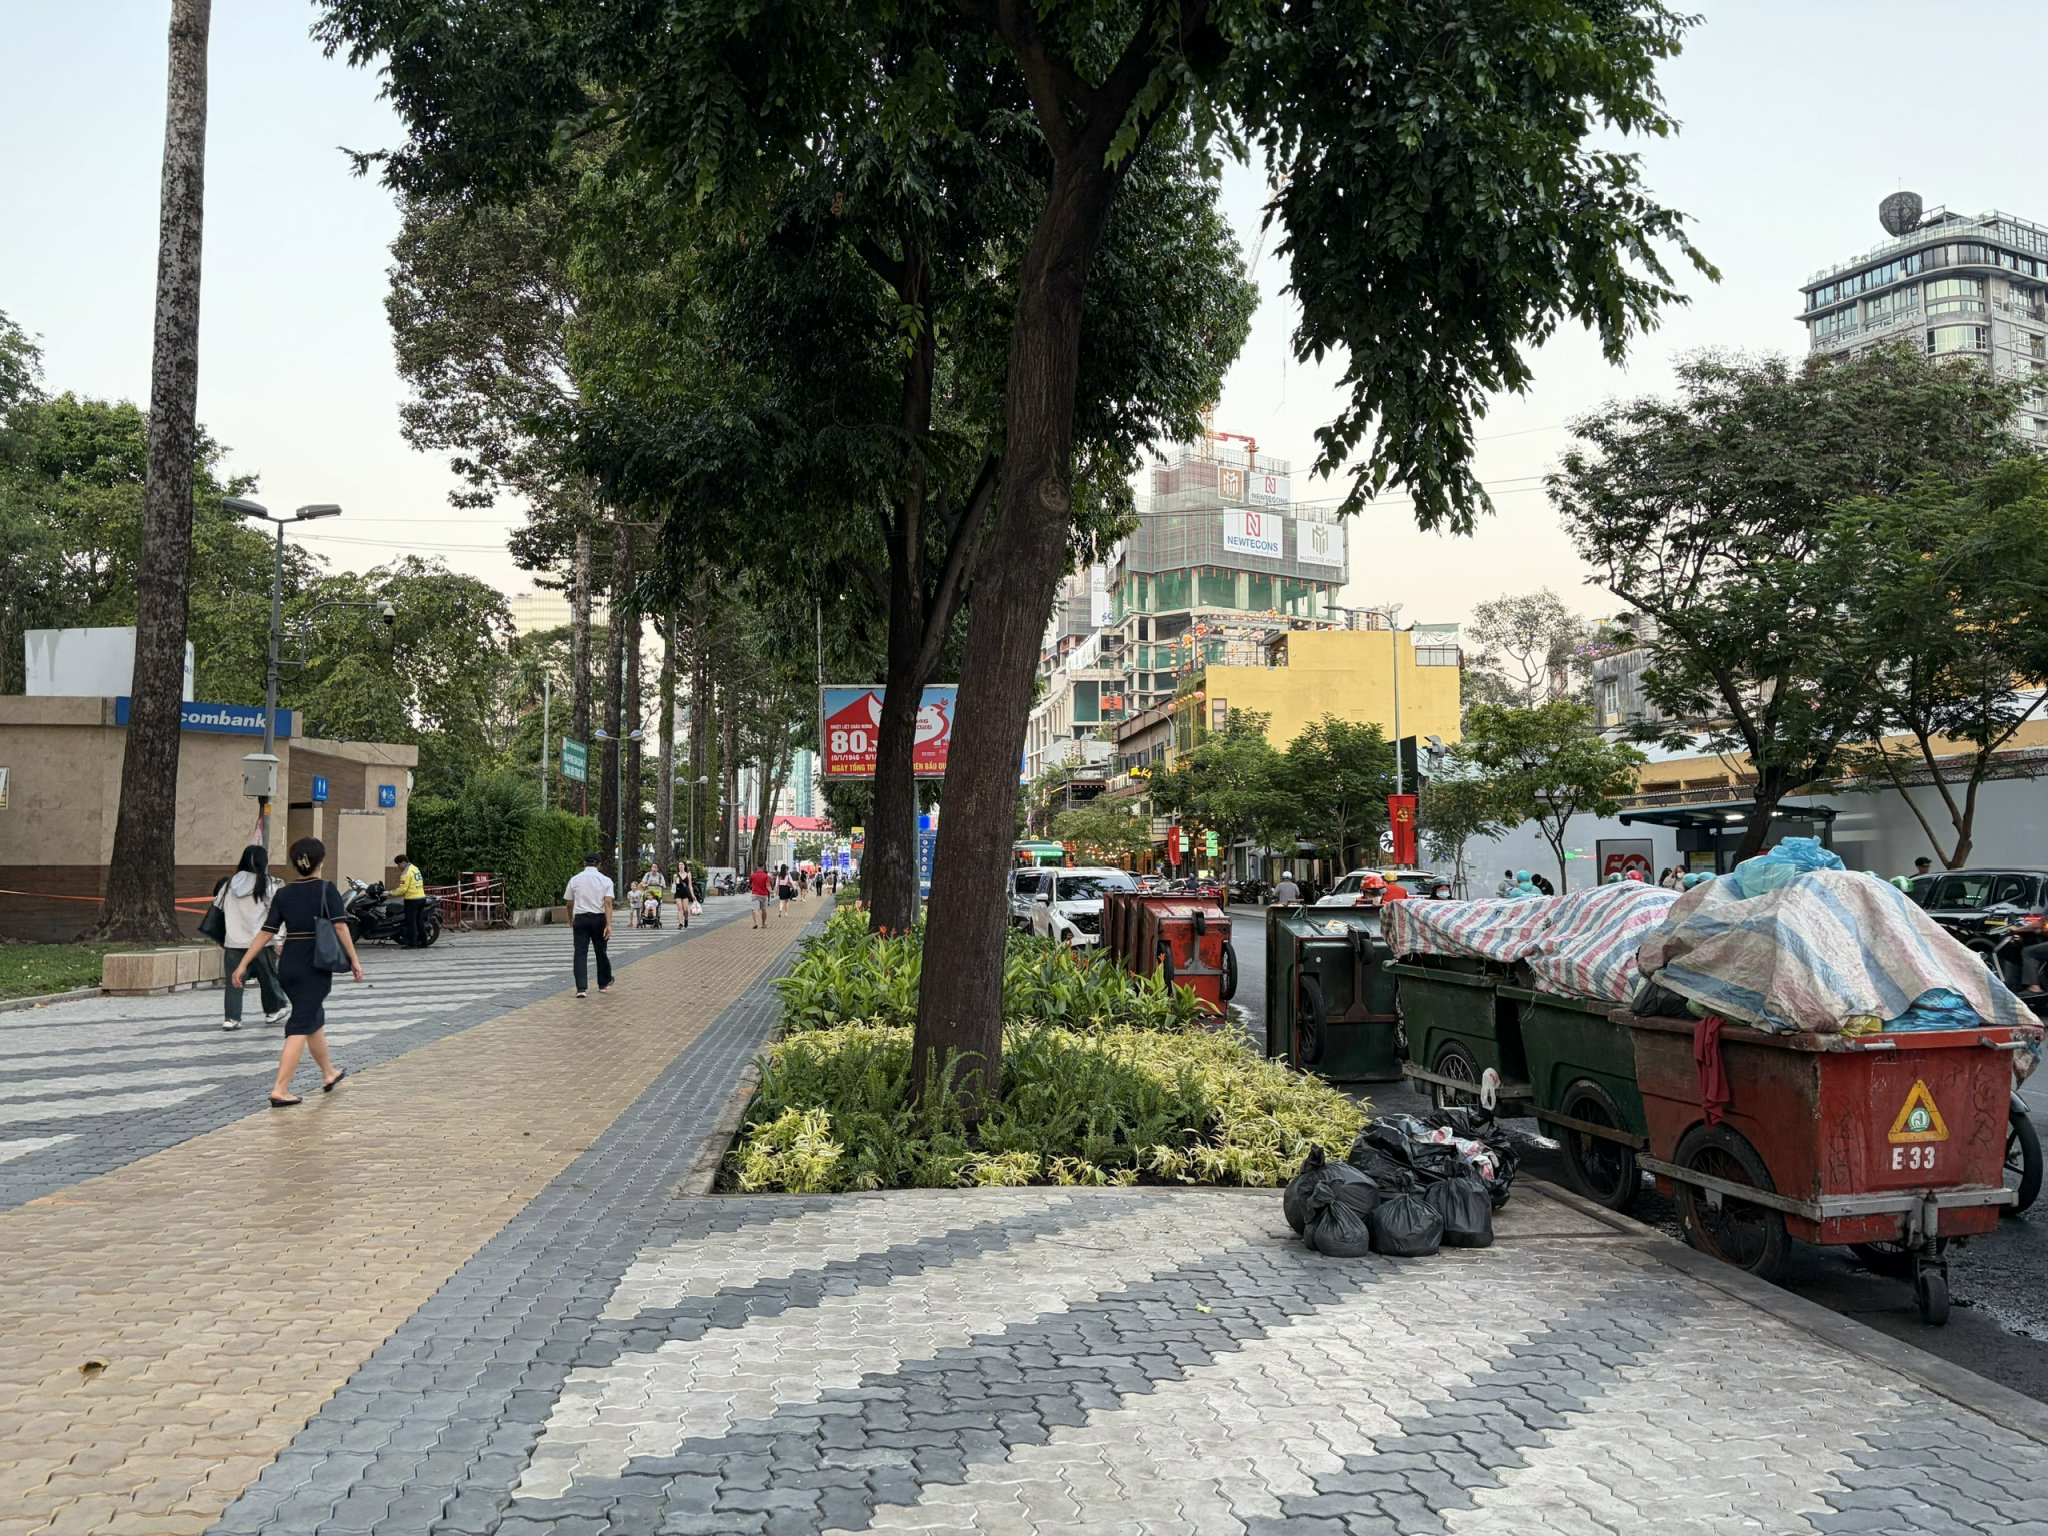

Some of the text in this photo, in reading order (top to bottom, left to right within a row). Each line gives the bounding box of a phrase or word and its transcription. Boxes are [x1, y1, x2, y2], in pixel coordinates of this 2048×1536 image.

[1227, 535, 1278, 552] NEWTECONS
[831, 730, 867, 753] 80
[831, 763, 848, 772] NGÀY
[1892, 1146, 1935, 1170] E 33
